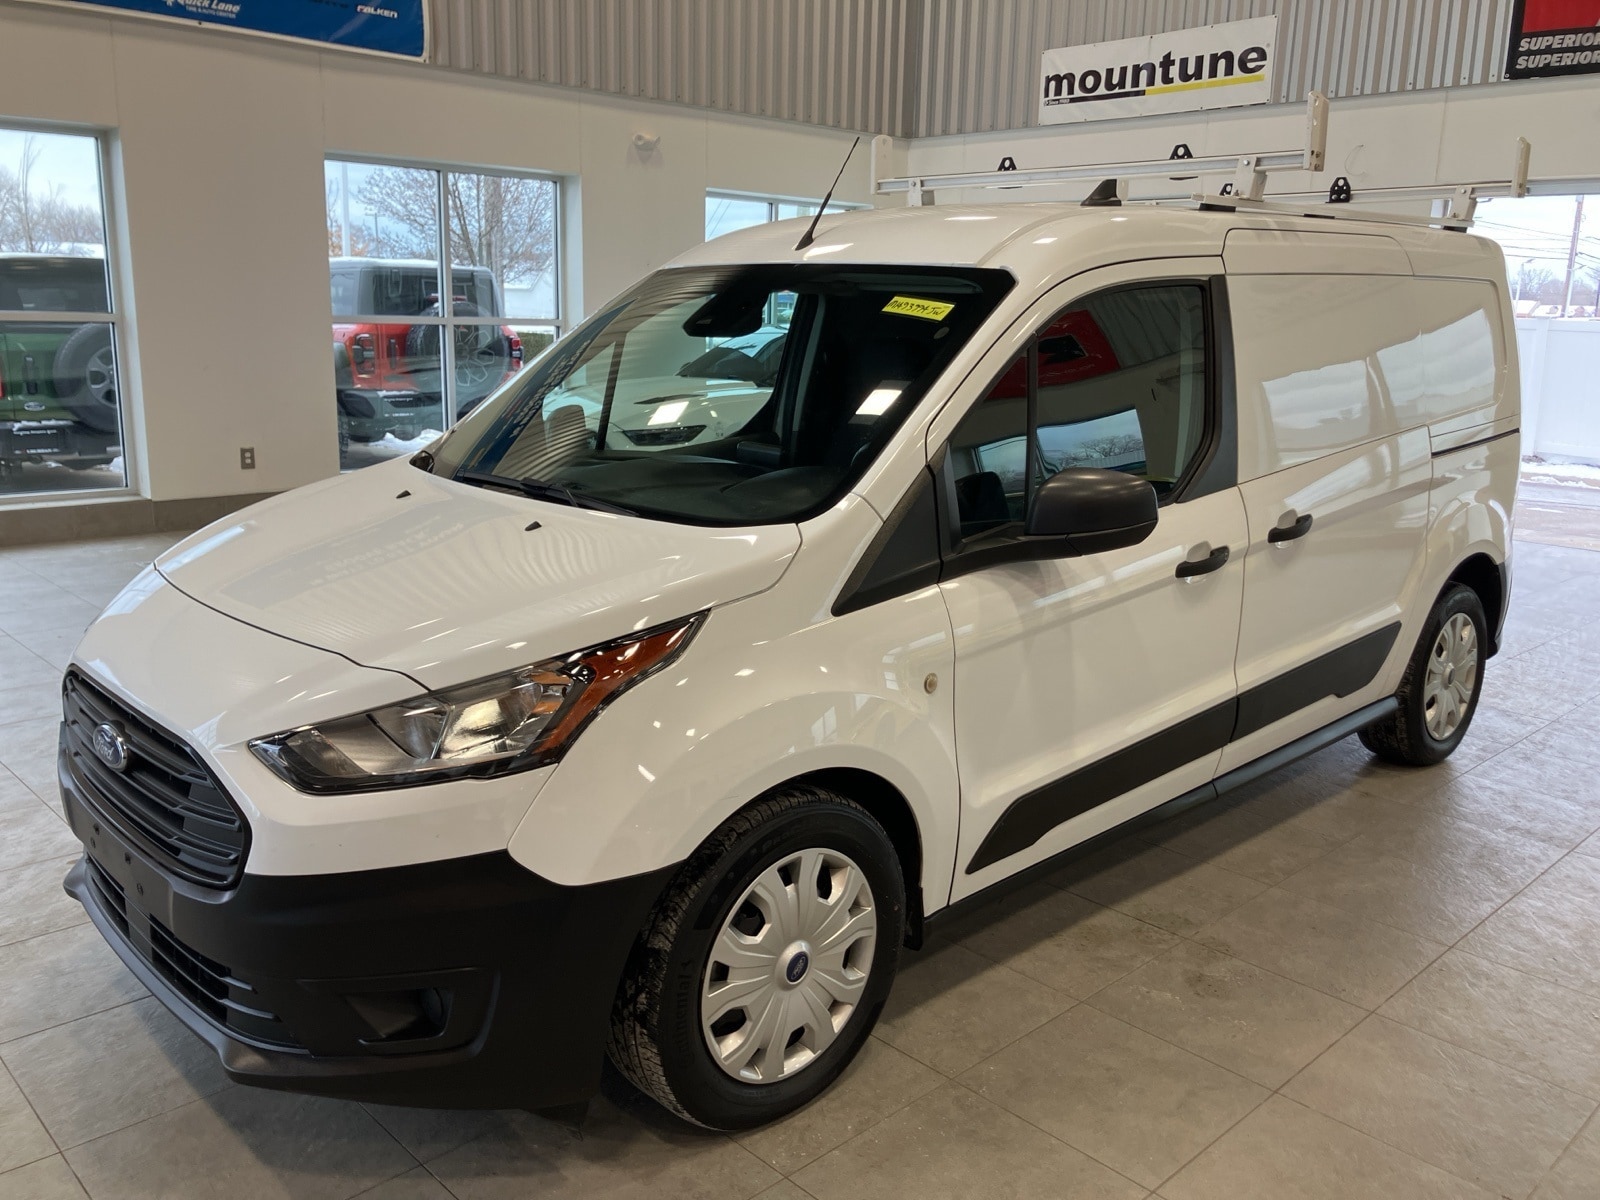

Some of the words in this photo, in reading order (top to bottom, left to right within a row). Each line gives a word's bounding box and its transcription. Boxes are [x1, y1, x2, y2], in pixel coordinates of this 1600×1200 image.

[211, 0, 241, 13] Lane
[357, 5, 398, 19] FALKEN
[1518, 32, 1600, 51] SUPERIOR
[1515, 50, 1600, 69] SUPERIOR
[1044, 46, 1268, 99] mountune
